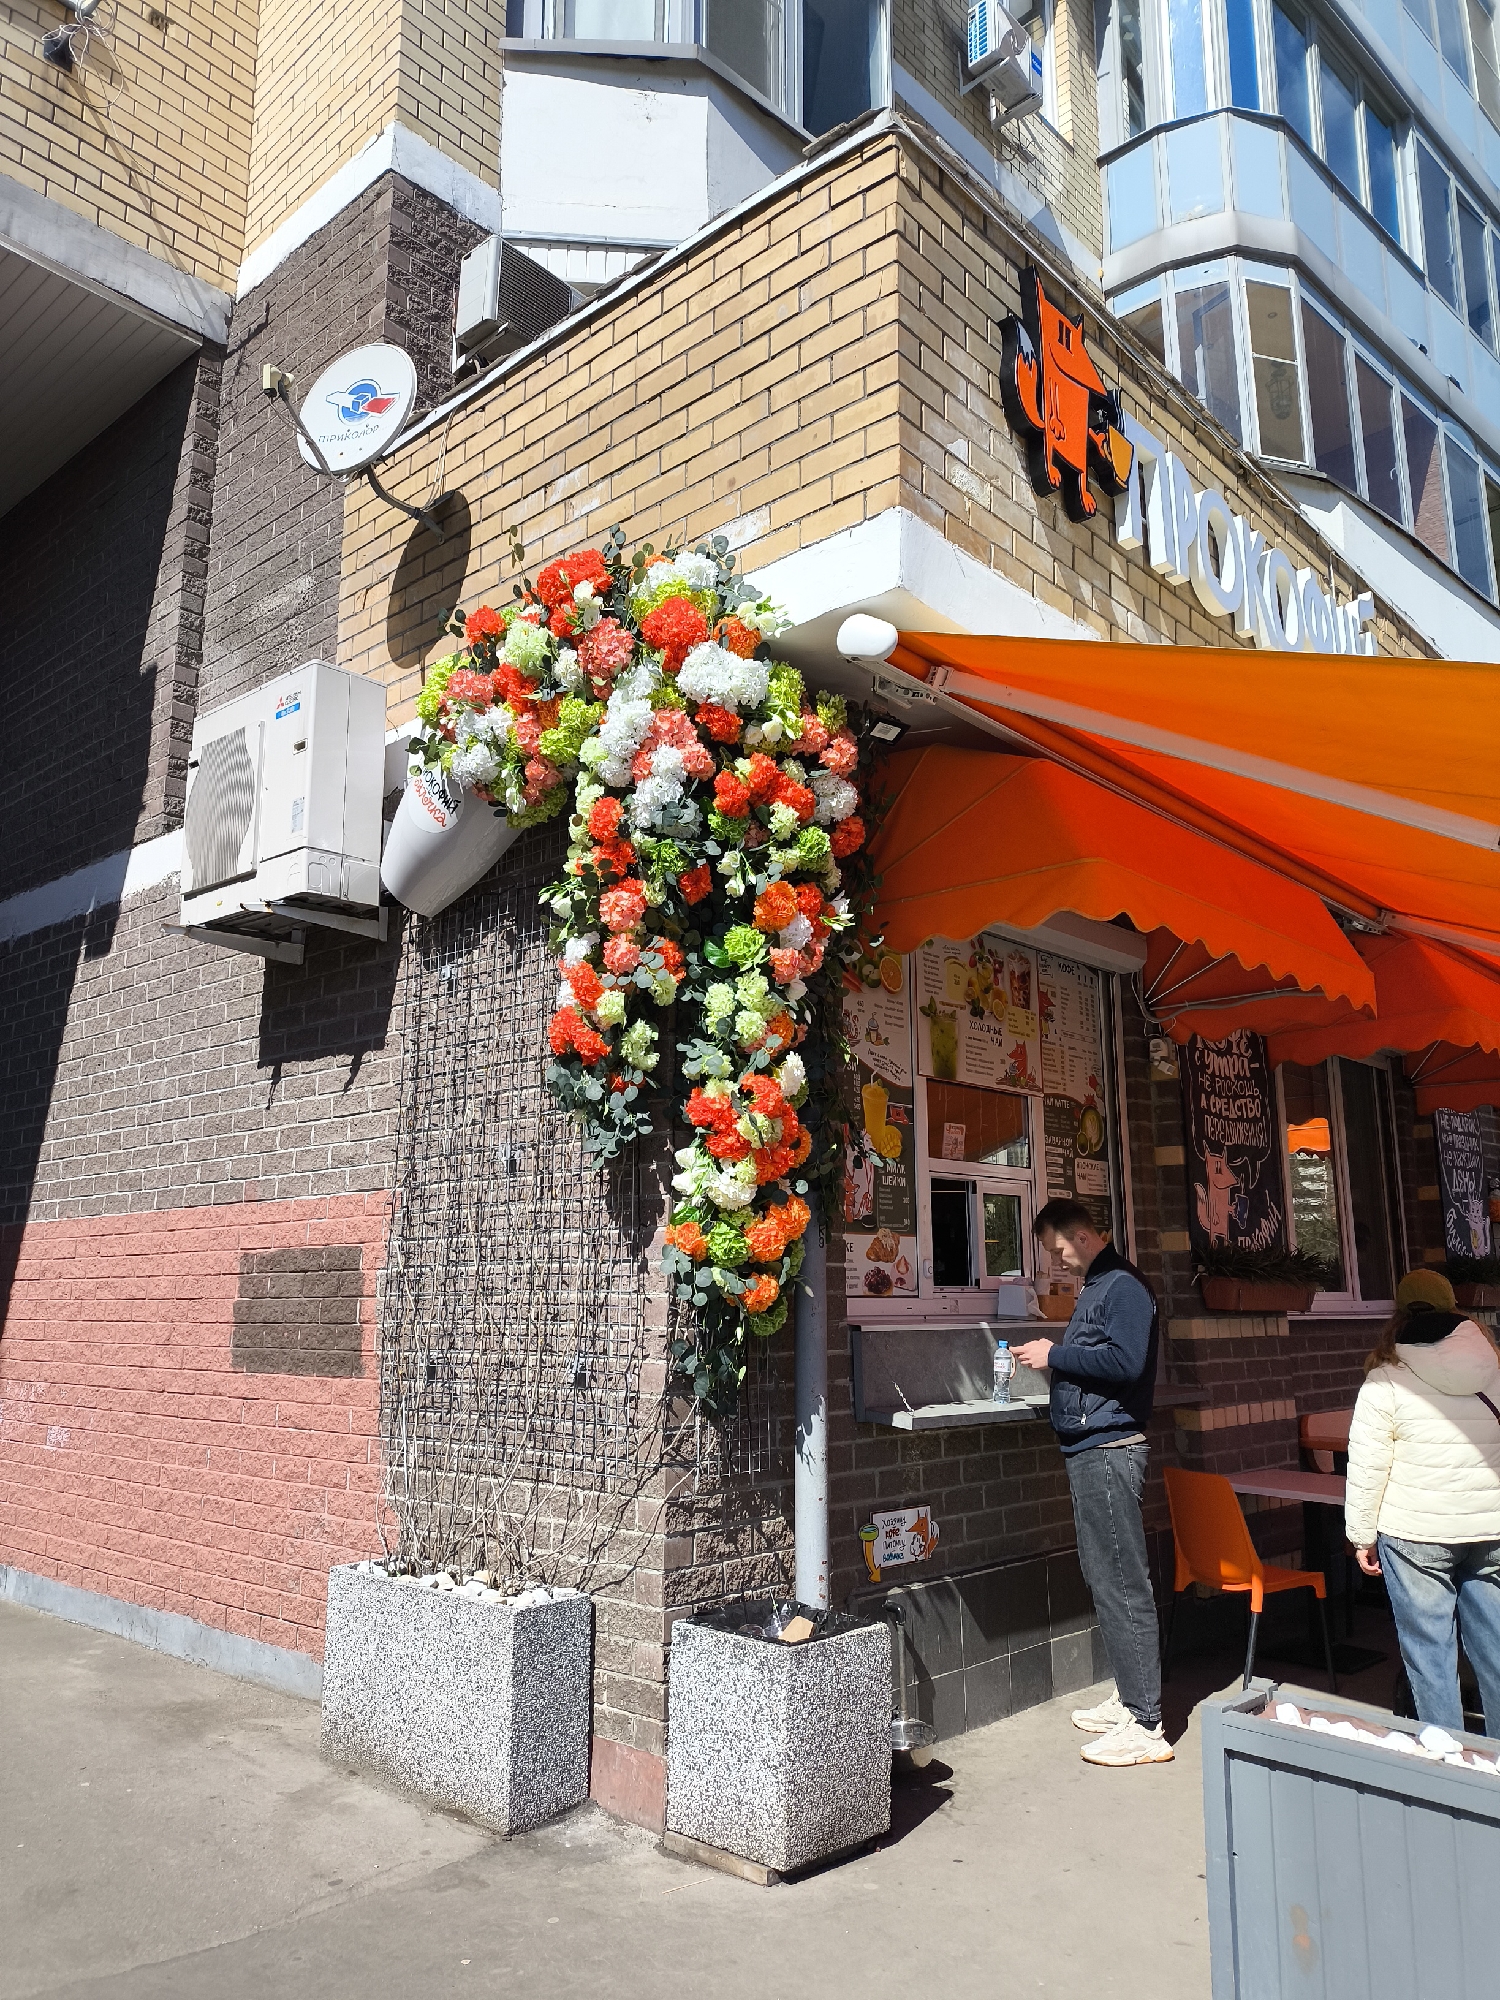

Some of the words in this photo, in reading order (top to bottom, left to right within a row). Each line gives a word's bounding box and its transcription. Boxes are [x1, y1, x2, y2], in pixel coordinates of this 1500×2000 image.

[422, 767, 461, 816] ОКОФИЙ
[1057, 961, 1075, 975] КОФЕ
[969, 1020, 1003, 1036] ХОЛОДНЫЕ
[1198, 1072, 1212, 1091] НЕ
[1200, 1093, 1208, 1110] А
[1209, 1094, 1261, 1119] СРЕДСТВО
[1440, 1113, 1449, 1131] НЕ
[882, 1175, 906, 1187] ШЕЙКИ
[845, 1242, 854, 1252] КЕ
